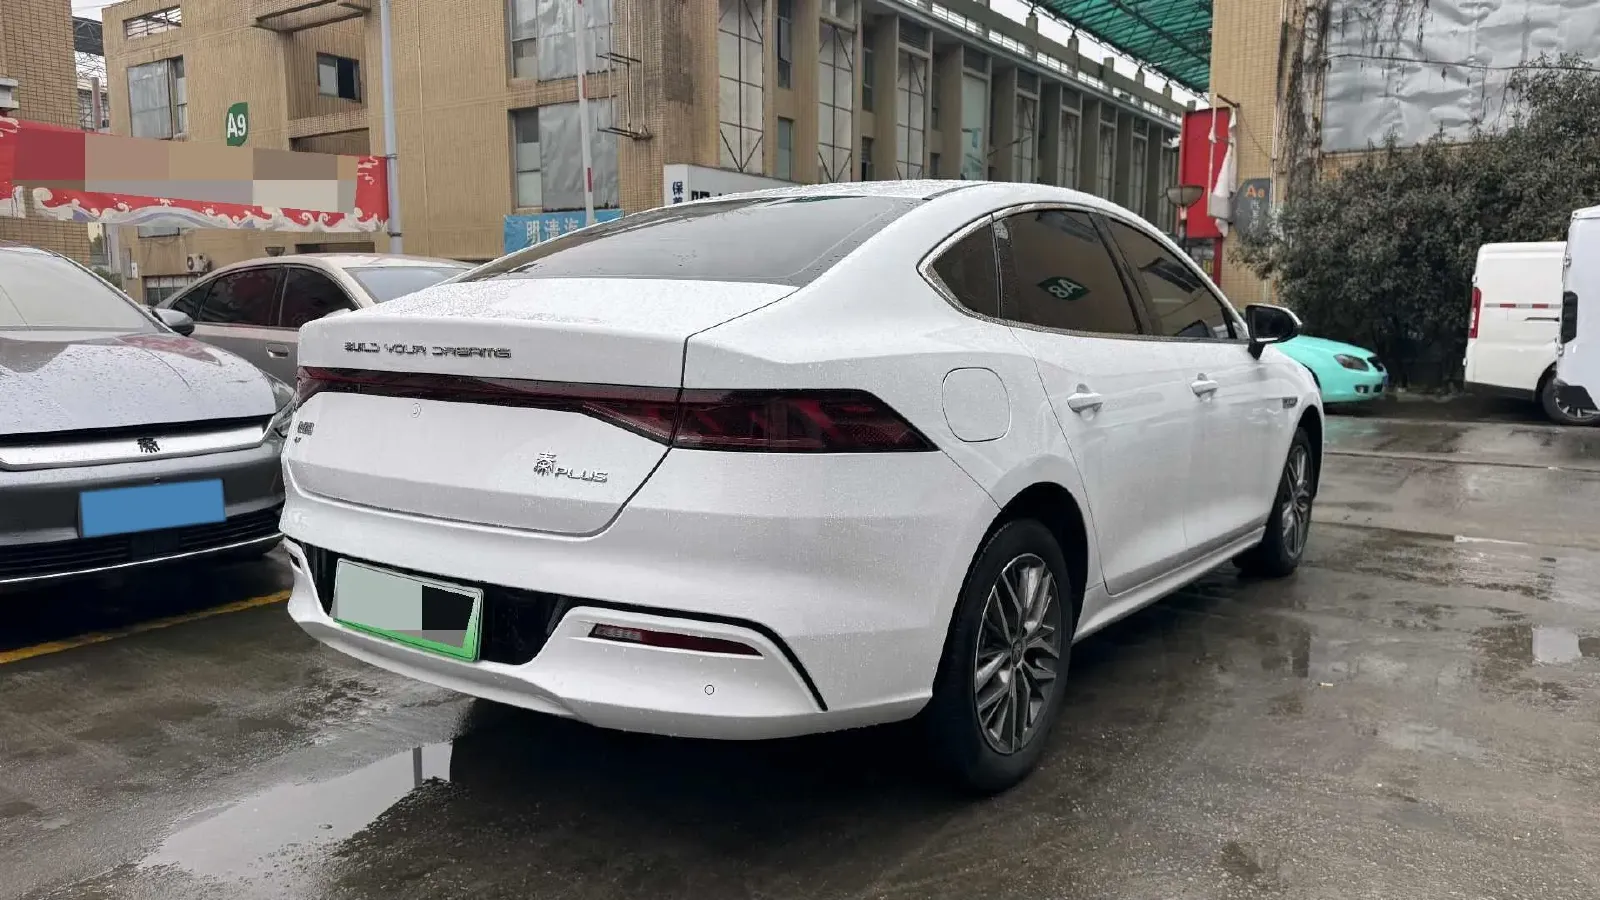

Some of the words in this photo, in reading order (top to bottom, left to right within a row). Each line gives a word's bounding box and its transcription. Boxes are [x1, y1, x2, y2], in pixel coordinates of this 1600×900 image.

[227, 112, 246, 138] A9
[344, 341, 380, 353] BUILD
[384, 343, 427, 355] YOUR
[432, 345, 512, 359] DREAMS
